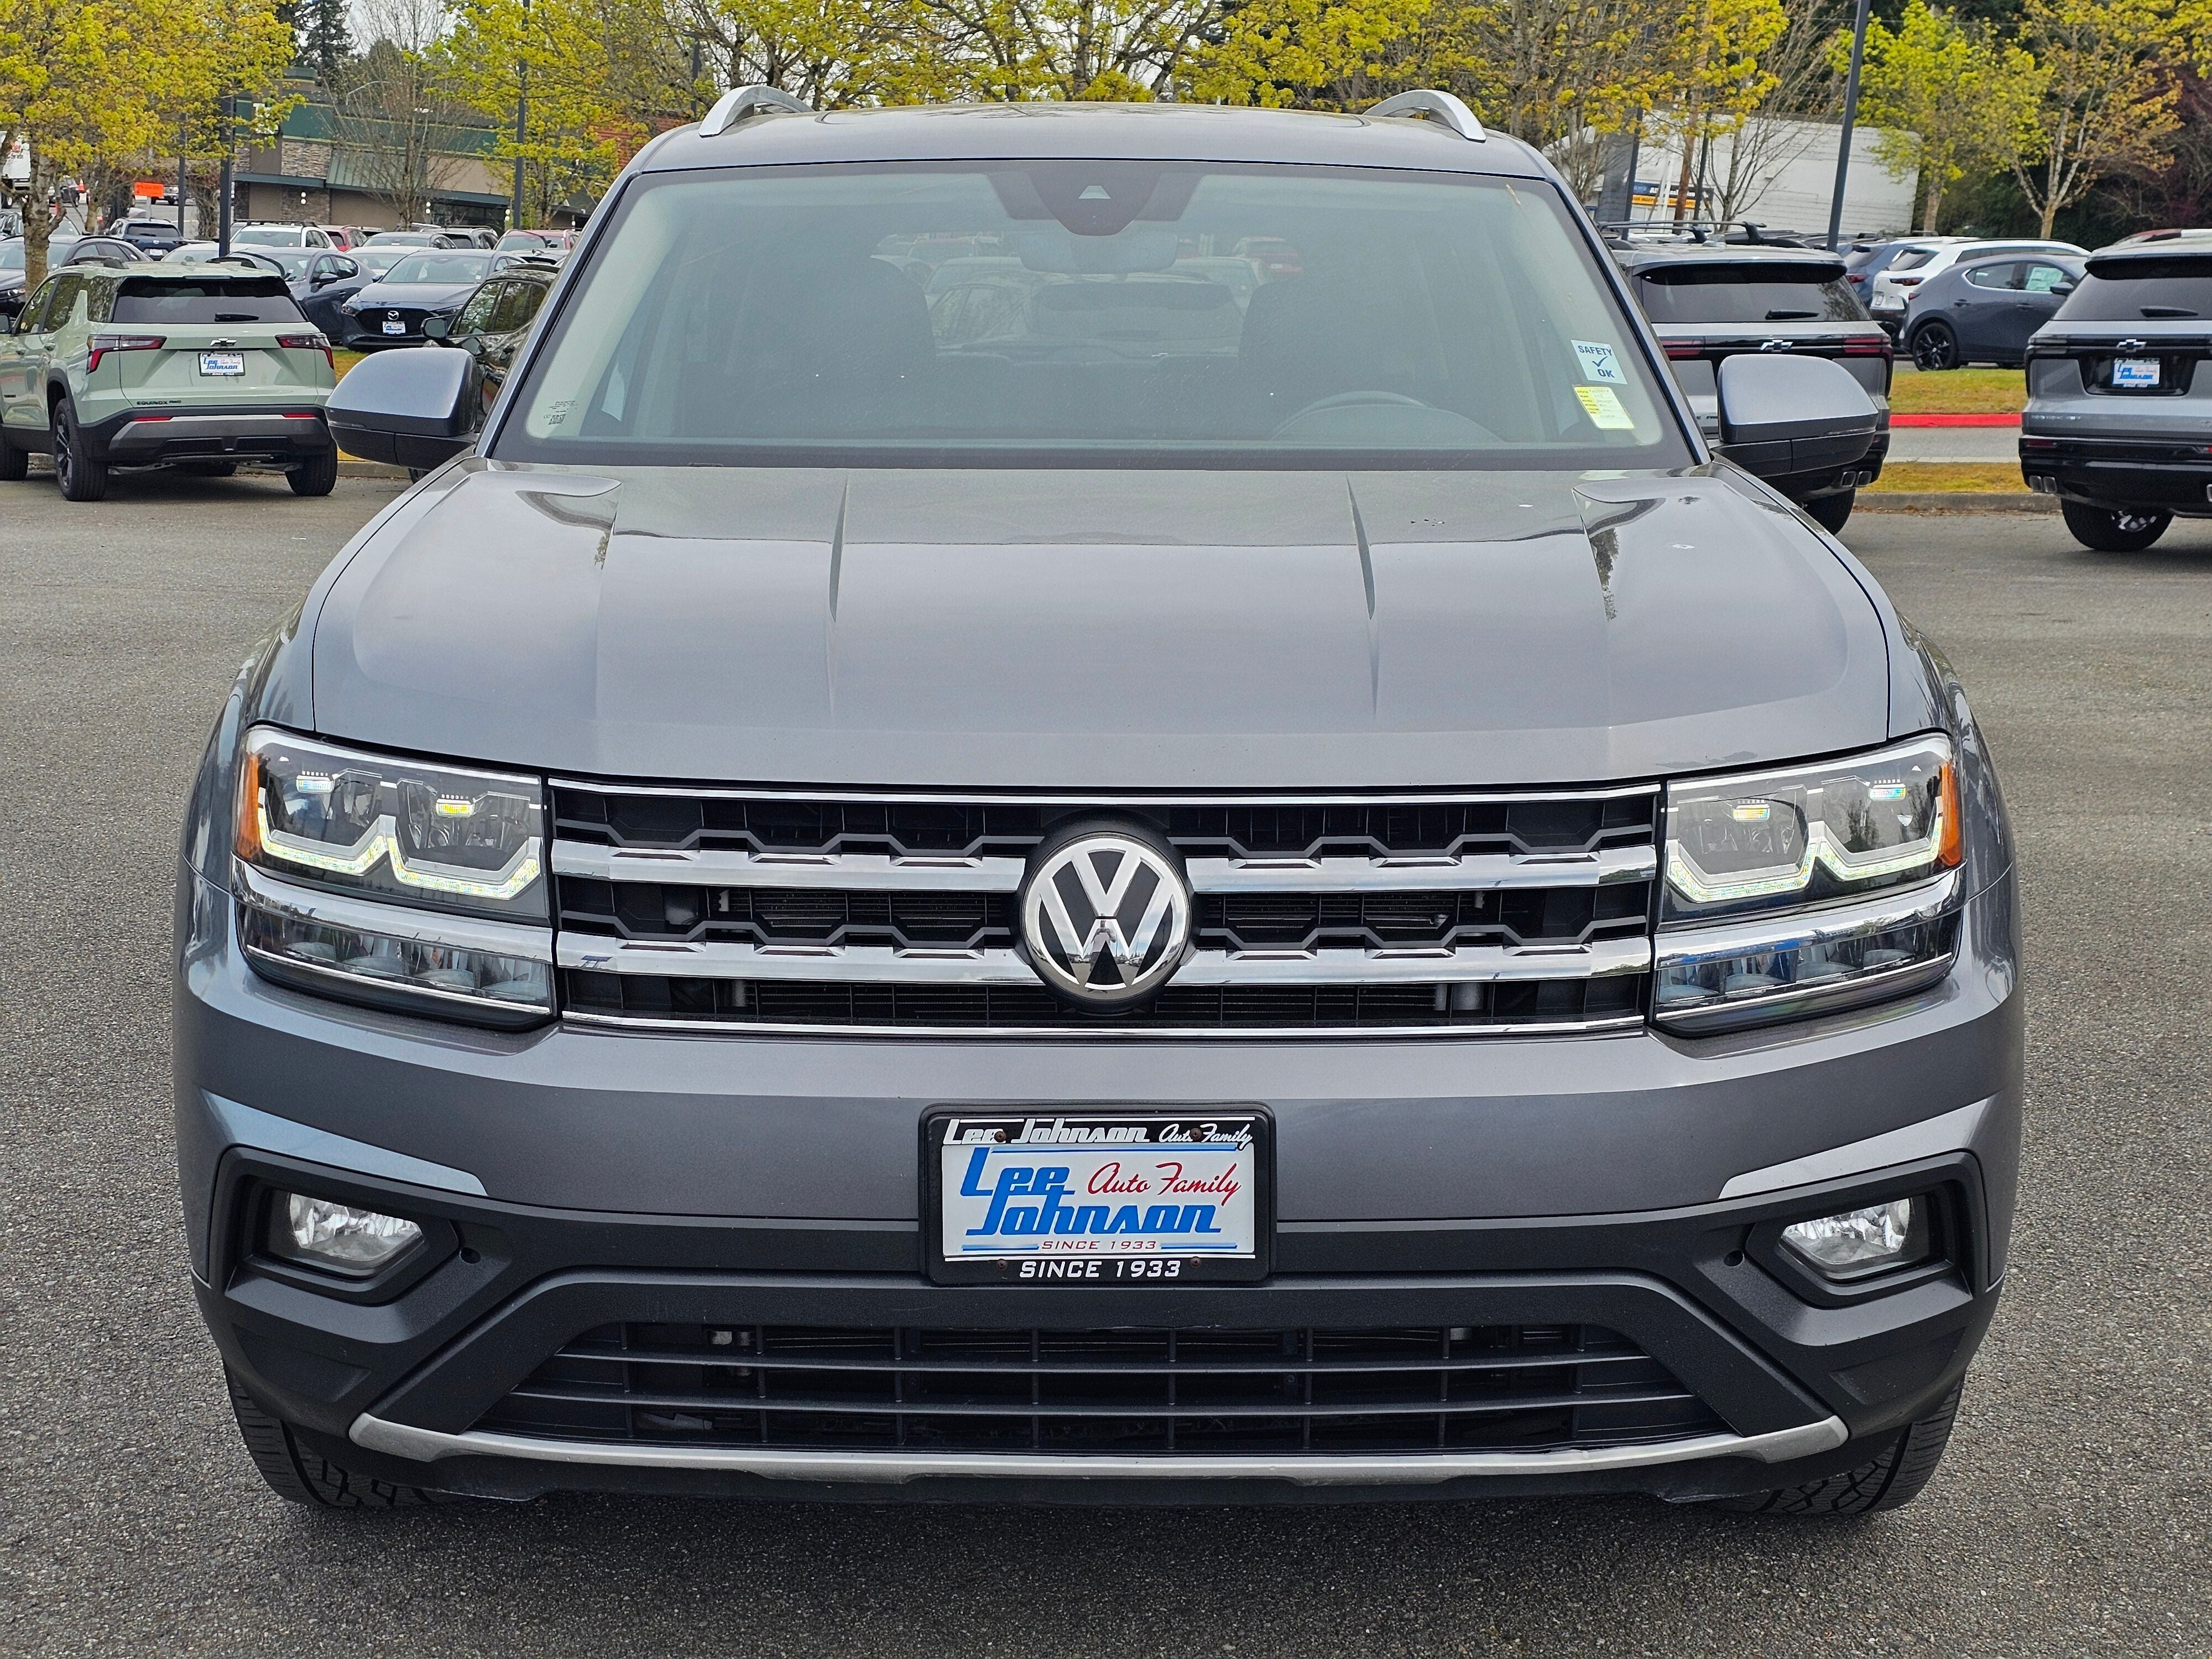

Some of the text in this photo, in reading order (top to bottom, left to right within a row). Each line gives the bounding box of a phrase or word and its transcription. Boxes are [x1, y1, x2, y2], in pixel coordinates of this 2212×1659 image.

[1578, 345, 1612, 356] SAFETY
[1597, 368, 1615, 378] OK
[943, 1118, 1253, 1150] Lee Johnson Aut Family
[959, 1147, 1076, 1196] Lee
[1088, 1162, 1242, 1207] Auto Family
[965, 1192, 1222, 1236] Johnson
[1041, 1240, 1157, 1250] SINCE 1933
[1019, 1260, 1181, 1278] SINCE 1933
